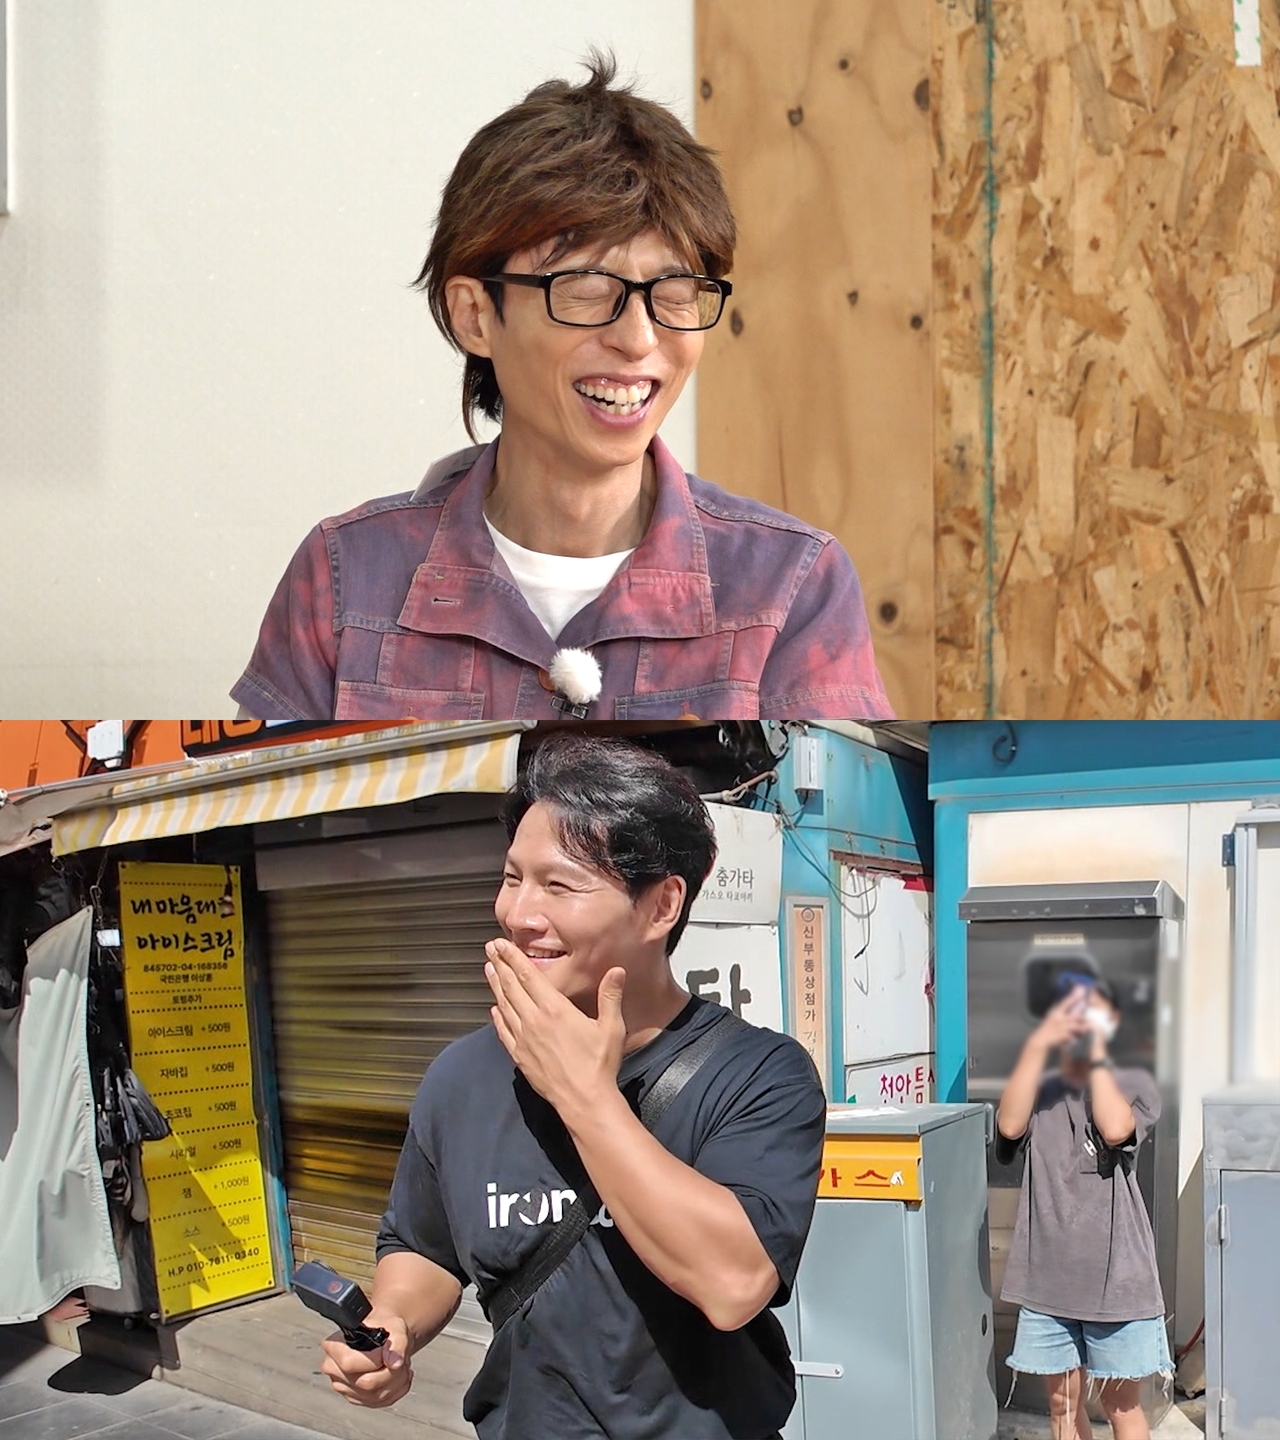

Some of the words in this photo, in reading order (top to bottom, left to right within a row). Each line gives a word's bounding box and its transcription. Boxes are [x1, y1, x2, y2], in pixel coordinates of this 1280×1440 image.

[136, 929, 235, 960] 아이스크림
[803, 926, 817, 1022] 신부동상점가
[148, 1024, 193, 1039] 아이스크림
[182, 1187, 192, 1198] 잼
[168, 1266, 184, 1278] H.P
